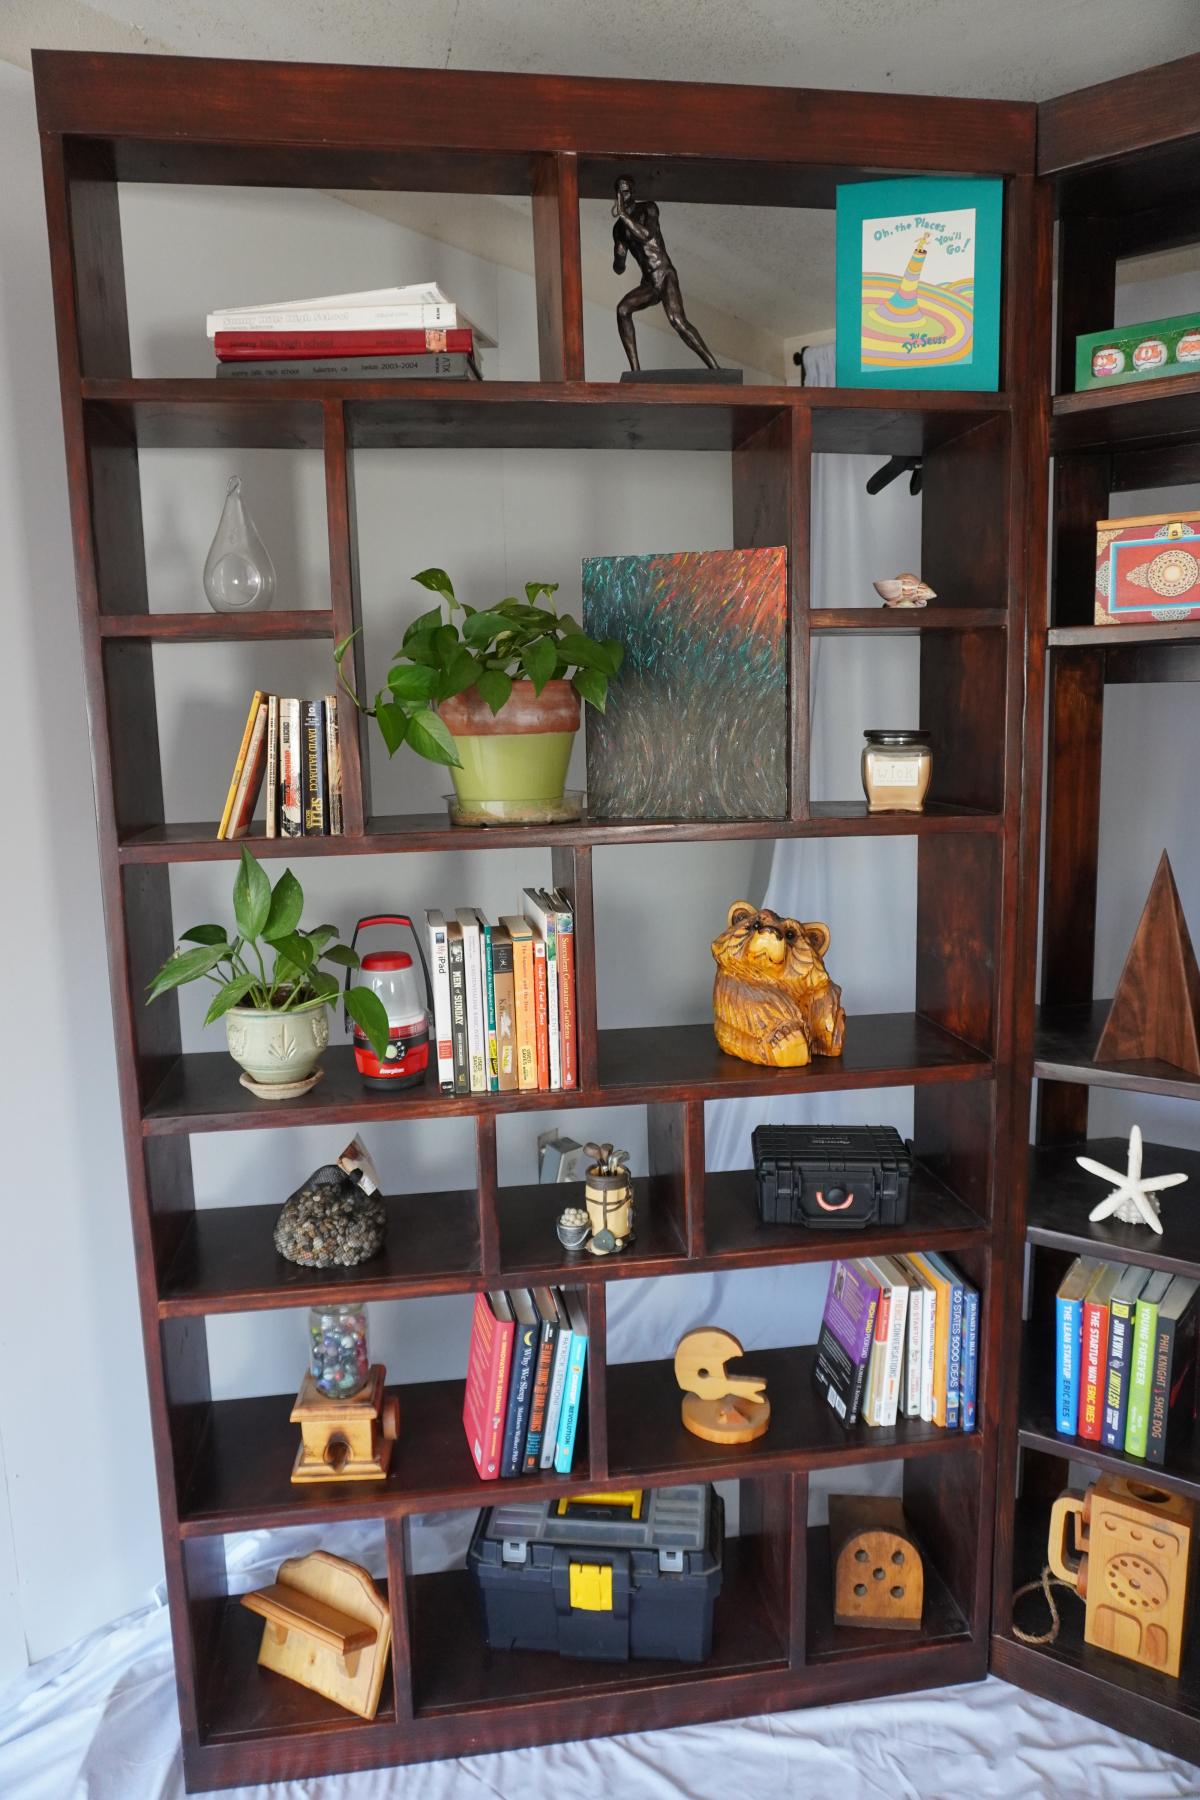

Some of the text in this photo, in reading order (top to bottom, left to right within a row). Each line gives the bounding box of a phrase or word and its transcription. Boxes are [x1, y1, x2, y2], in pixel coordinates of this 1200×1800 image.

[873, 217, 947, 241] Oh, the Places
[934, 231, 962, 245] You'll
[946, 238, 971, 255] Go!
[901, 333, 947, 354] Dr. Seuss
[381, 361, 418, 370] 2003-2004
[308, 728, 318, 752] DAVID
[308, 753, 318, 792] BALDACCI
[310, 797, 323, 829] SPLIT
[438, 956, 447, 974] iPad
[561, 937, 570, 973] Succulent
[452, 970, 462, 988] MEN
[562, 973, 571, 1009] Container
[454, 994, 464, 1026] SUNDAY
[563, 1009, 572, 1040] Gardens
[865, 1319, 874, 1333] DAD
[869, 1302, 877, 1319] RICH
[950, 1290, 963, 1388] 50 STATES 5000 IDEAS
[1135, 1307, 1151, 1386] YOUNG FOREVER
[516, 1348, 532, 1403] Why We Sleep
[1062, 1305, 1073, 1418] THE LEAN STARTUP ERIC RIES
[1085, 1311, 1101, 1424] THE STARTUP WAY ERIC RIES
[1107, 1319, 1125, 1409] JIM KWIK LIMITLESS
[1155, 1334, 1170, 1388] PHIL KNIGHT
[495, 1385, 503, 1414] DILEMMA
[1151, 1395, 1165, 1439] SHOE DOG
